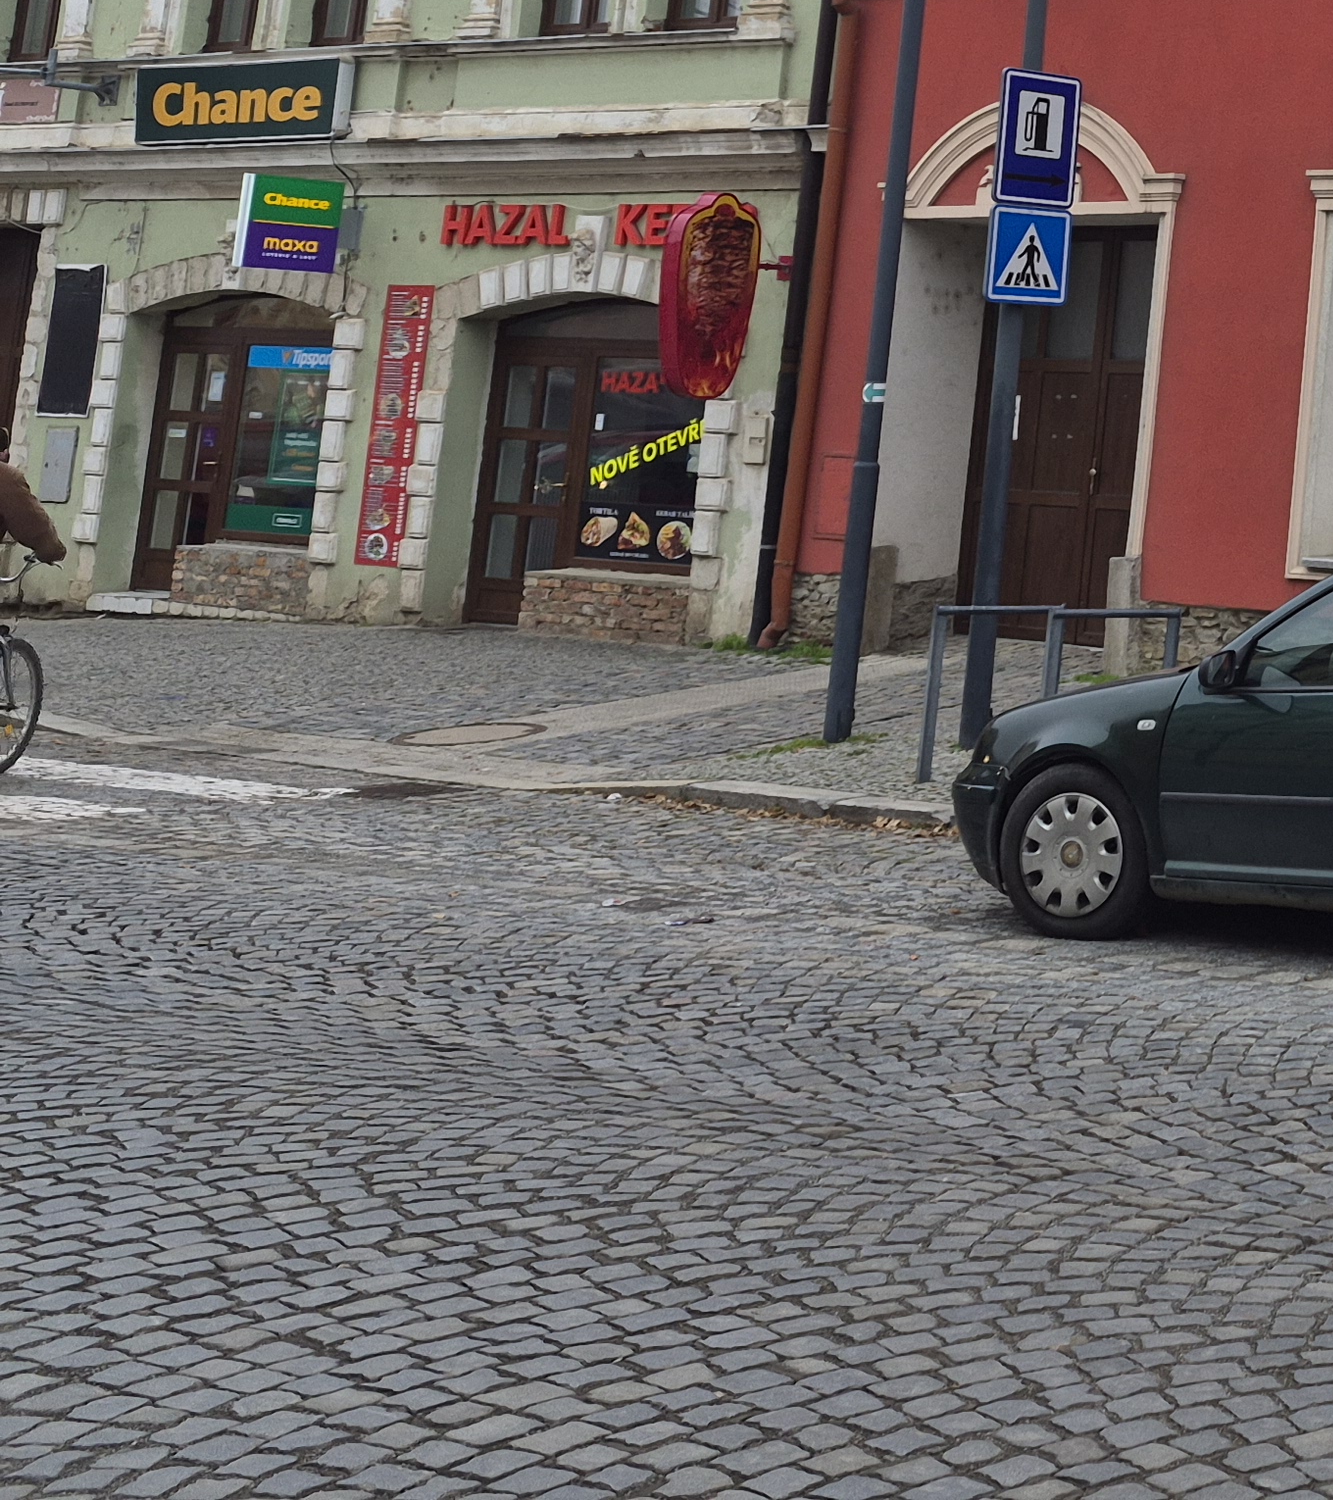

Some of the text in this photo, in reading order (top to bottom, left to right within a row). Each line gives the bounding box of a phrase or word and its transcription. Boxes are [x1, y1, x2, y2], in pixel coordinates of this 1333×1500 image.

[153, 82, 322, 127] Chance
[264, 192, 332, 211] Chance
[440, 203, 692, 246] HAZAL KE
[263, 237, 319, 253] maxa
